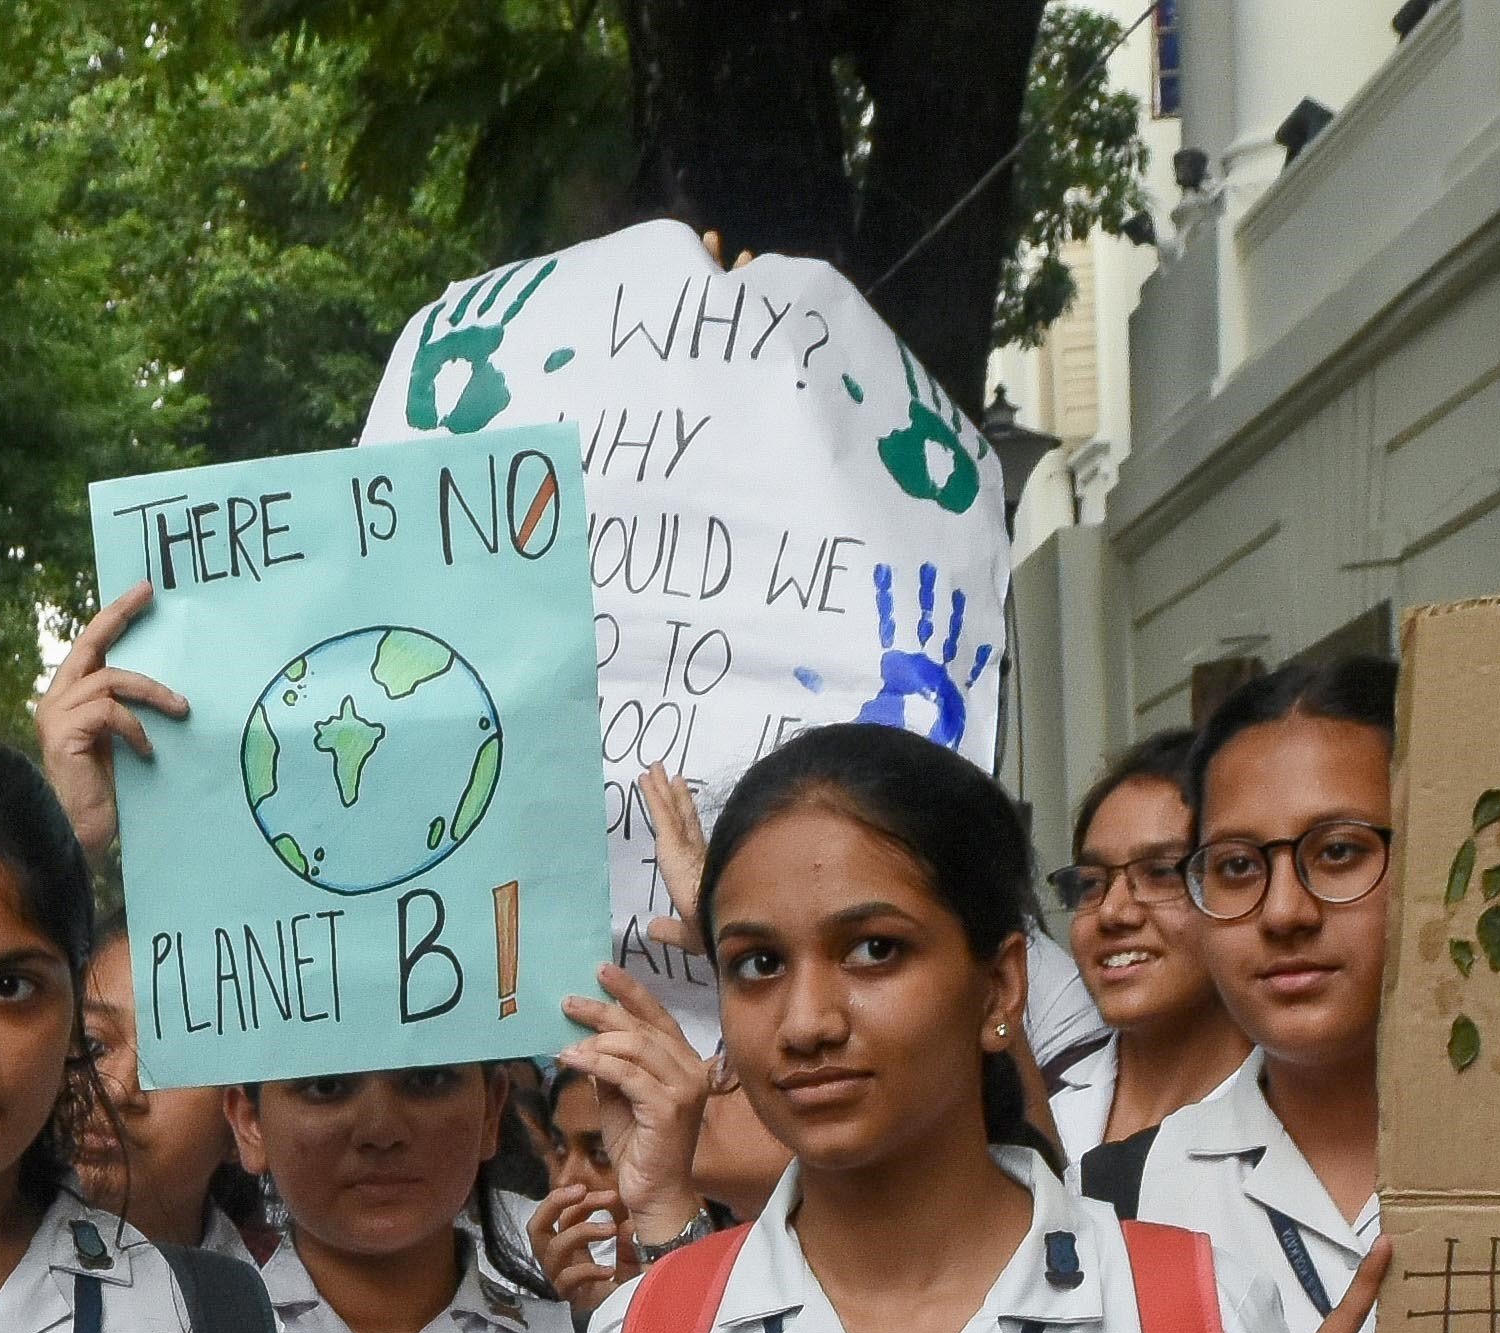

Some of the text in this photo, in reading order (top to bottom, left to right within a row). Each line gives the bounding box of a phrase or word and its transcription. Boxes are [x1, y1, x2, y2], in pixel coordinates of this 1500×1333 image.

[608, 275, 833, 391] WHY?
[113, 449, 562, 591] THERE IS NO
[765, 530, 867, 613] WE
[662, 620, 732, 697] TO
[151, 910, 346, 1040] PLANET
